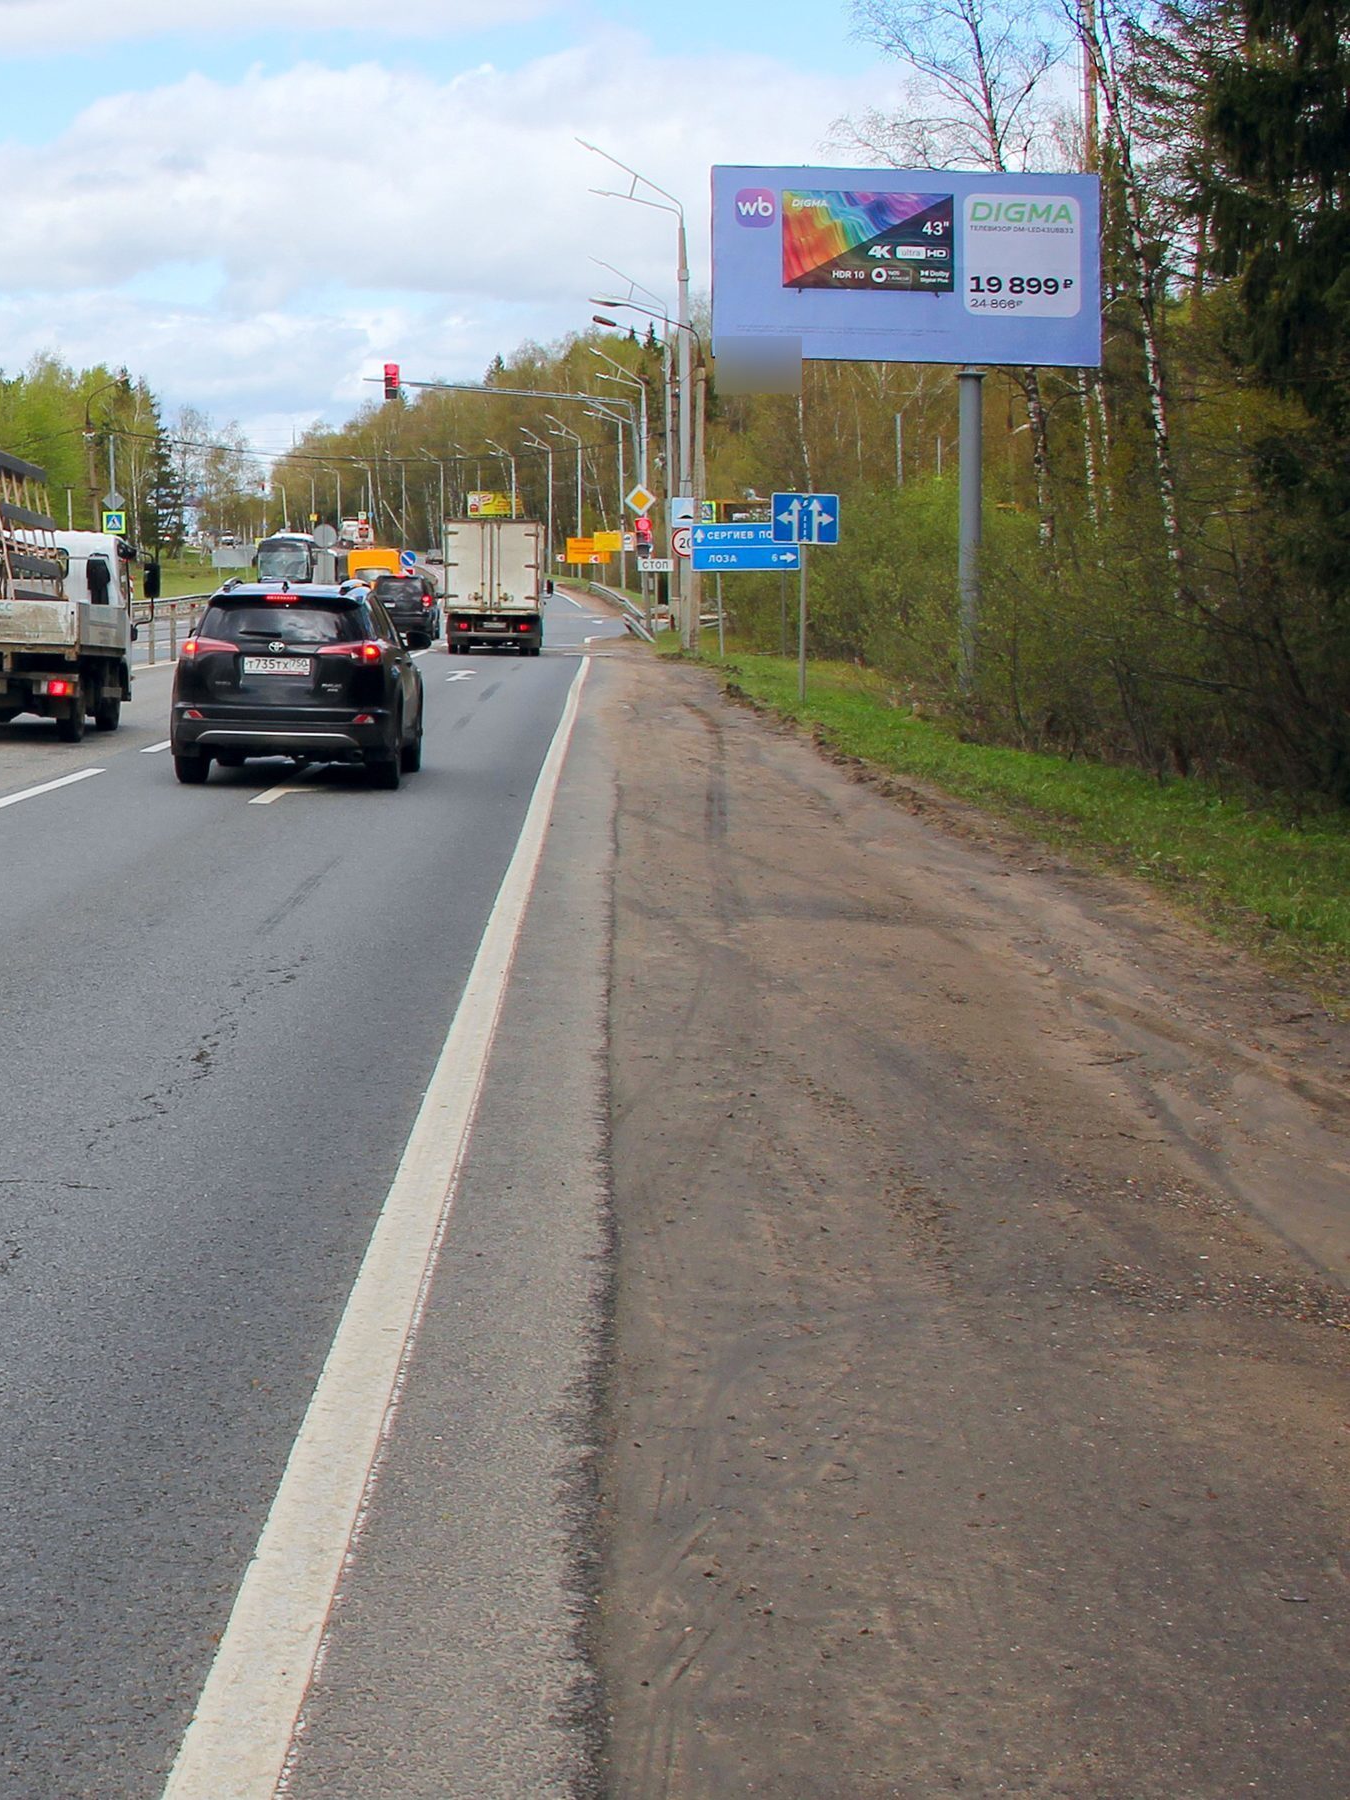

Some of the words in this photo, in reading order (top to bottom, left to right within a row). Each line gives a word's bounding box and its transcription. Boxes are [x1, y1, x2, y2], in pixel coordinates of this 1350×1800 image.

[737, 196, 773, 216] wb
[791, 198, 828, 208] DIGMA
[970, 201, 1073, 224] DIGMA
[970, 225, 1012, 233] ТЕЛЕВИЗОР
[868, 245, 891, 259] 4K
[927, 249, 947, 259] HD
[832, 270, 852, 280] HDR
[853, 270, 865, 280] 10
[970, 276, 1002, 294] 19
[1008, 276, 1060, 295] 899
[707, 530, 754, 540] СЕРГИЕВ
[708, 554, 738, 563] ЛОЗА
[642, 560, 669, 570] СТОП
